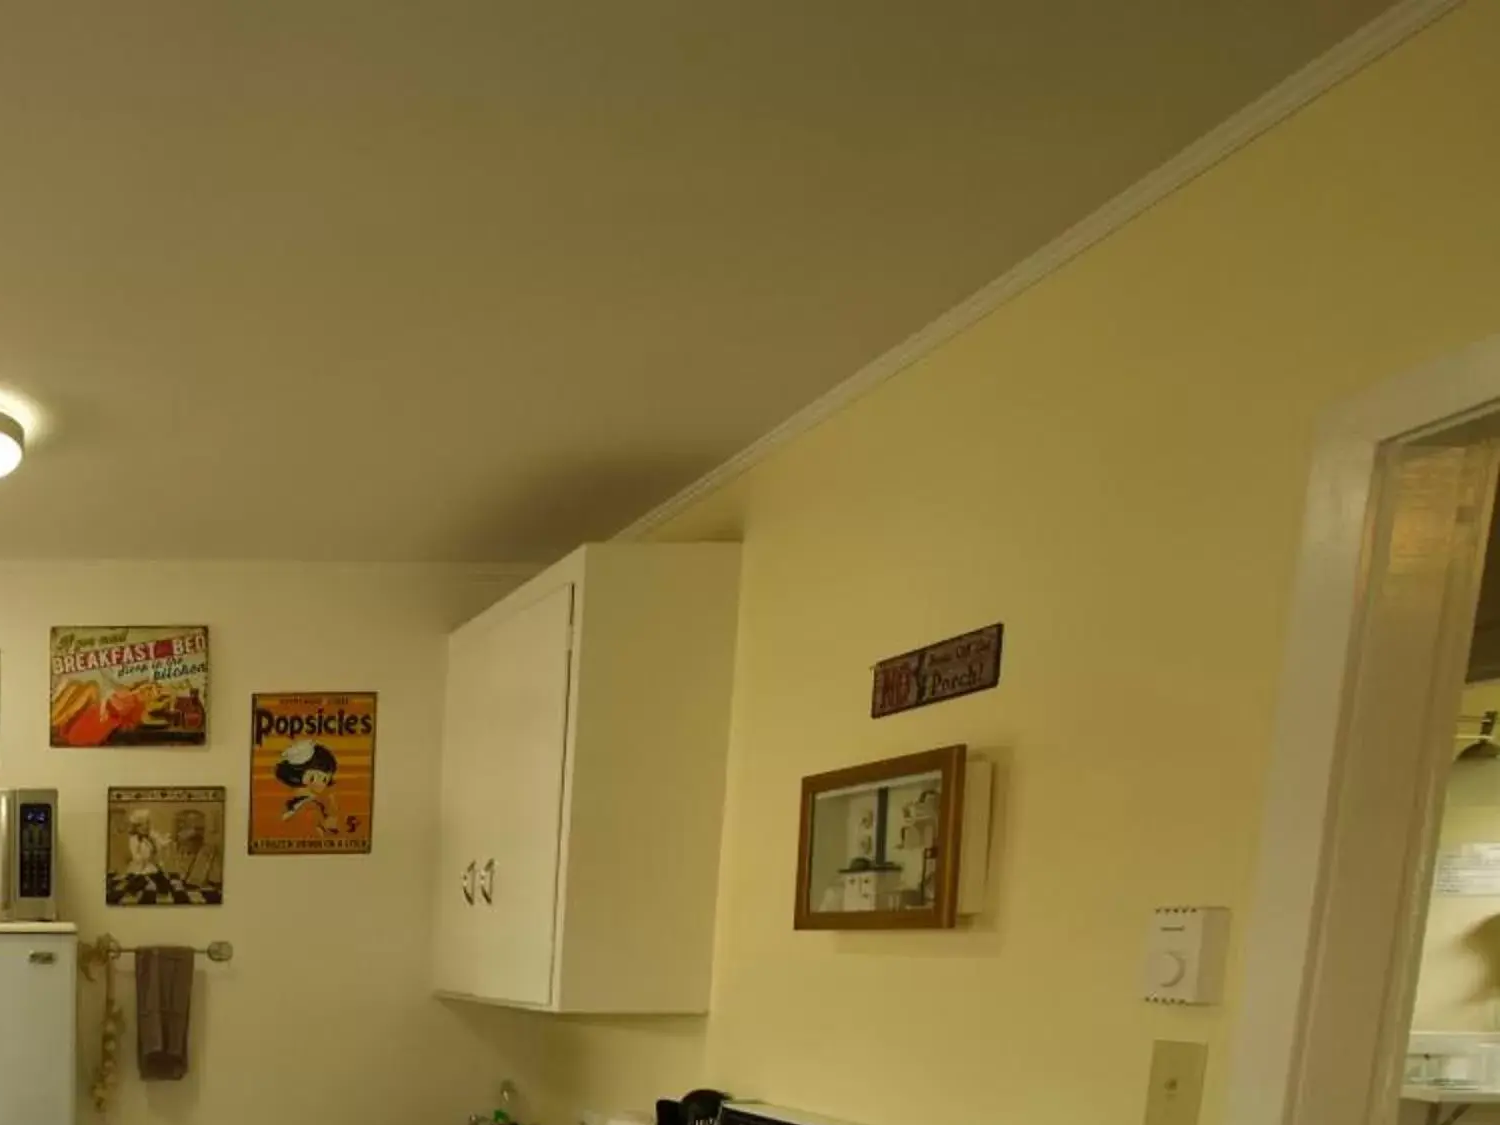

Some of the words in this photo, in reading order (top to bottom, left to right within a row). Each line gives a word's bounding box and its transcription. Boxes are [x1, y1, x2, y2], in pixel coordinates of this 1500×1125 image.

[52, 642, 156, 674] BREAKFAST
[172, 634, 206, 656] BED
[255, 707, 373, 747] Popsicles
